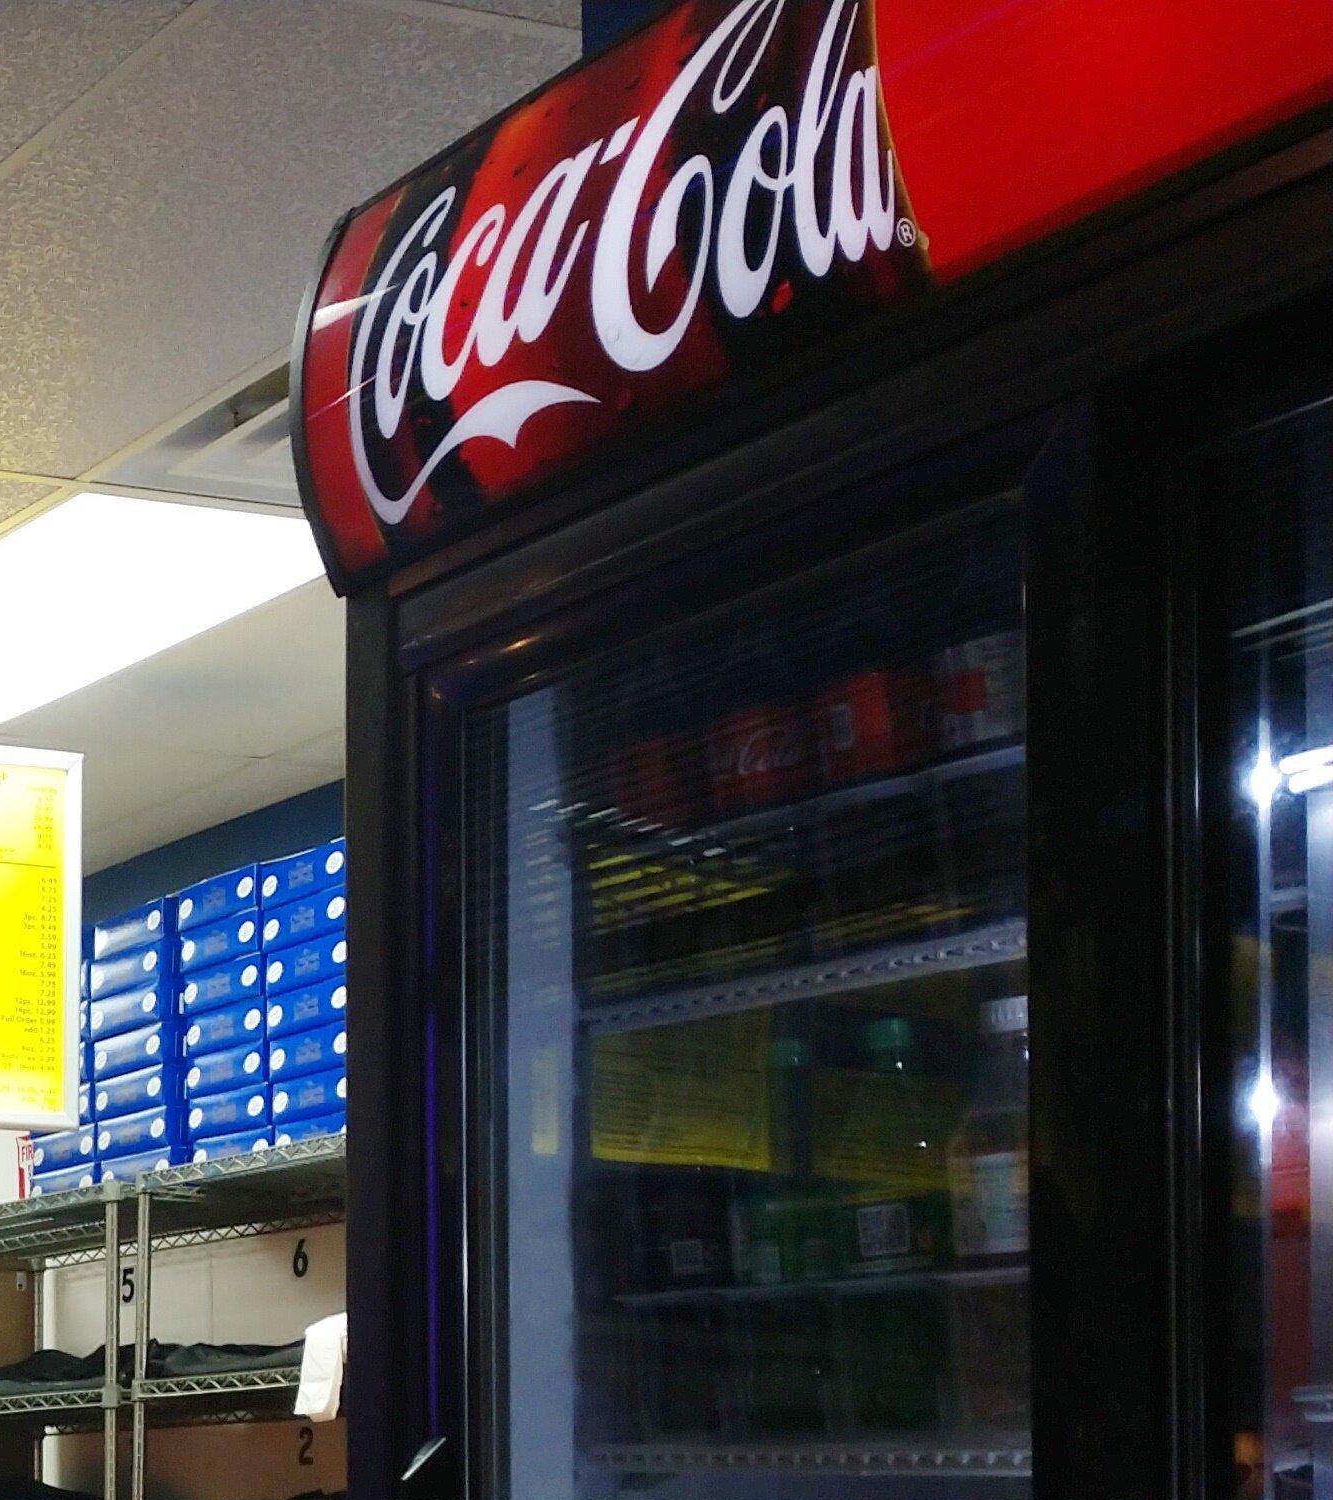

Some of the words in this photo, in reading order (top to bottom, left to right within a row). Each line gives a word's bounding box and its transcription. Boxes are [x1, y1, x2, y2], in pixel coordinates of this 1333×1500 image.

[292, 1238, 309, 1278] 6
[120, 1266, 134, 1303] 5
[298, 1426, 314, 1466] 2
